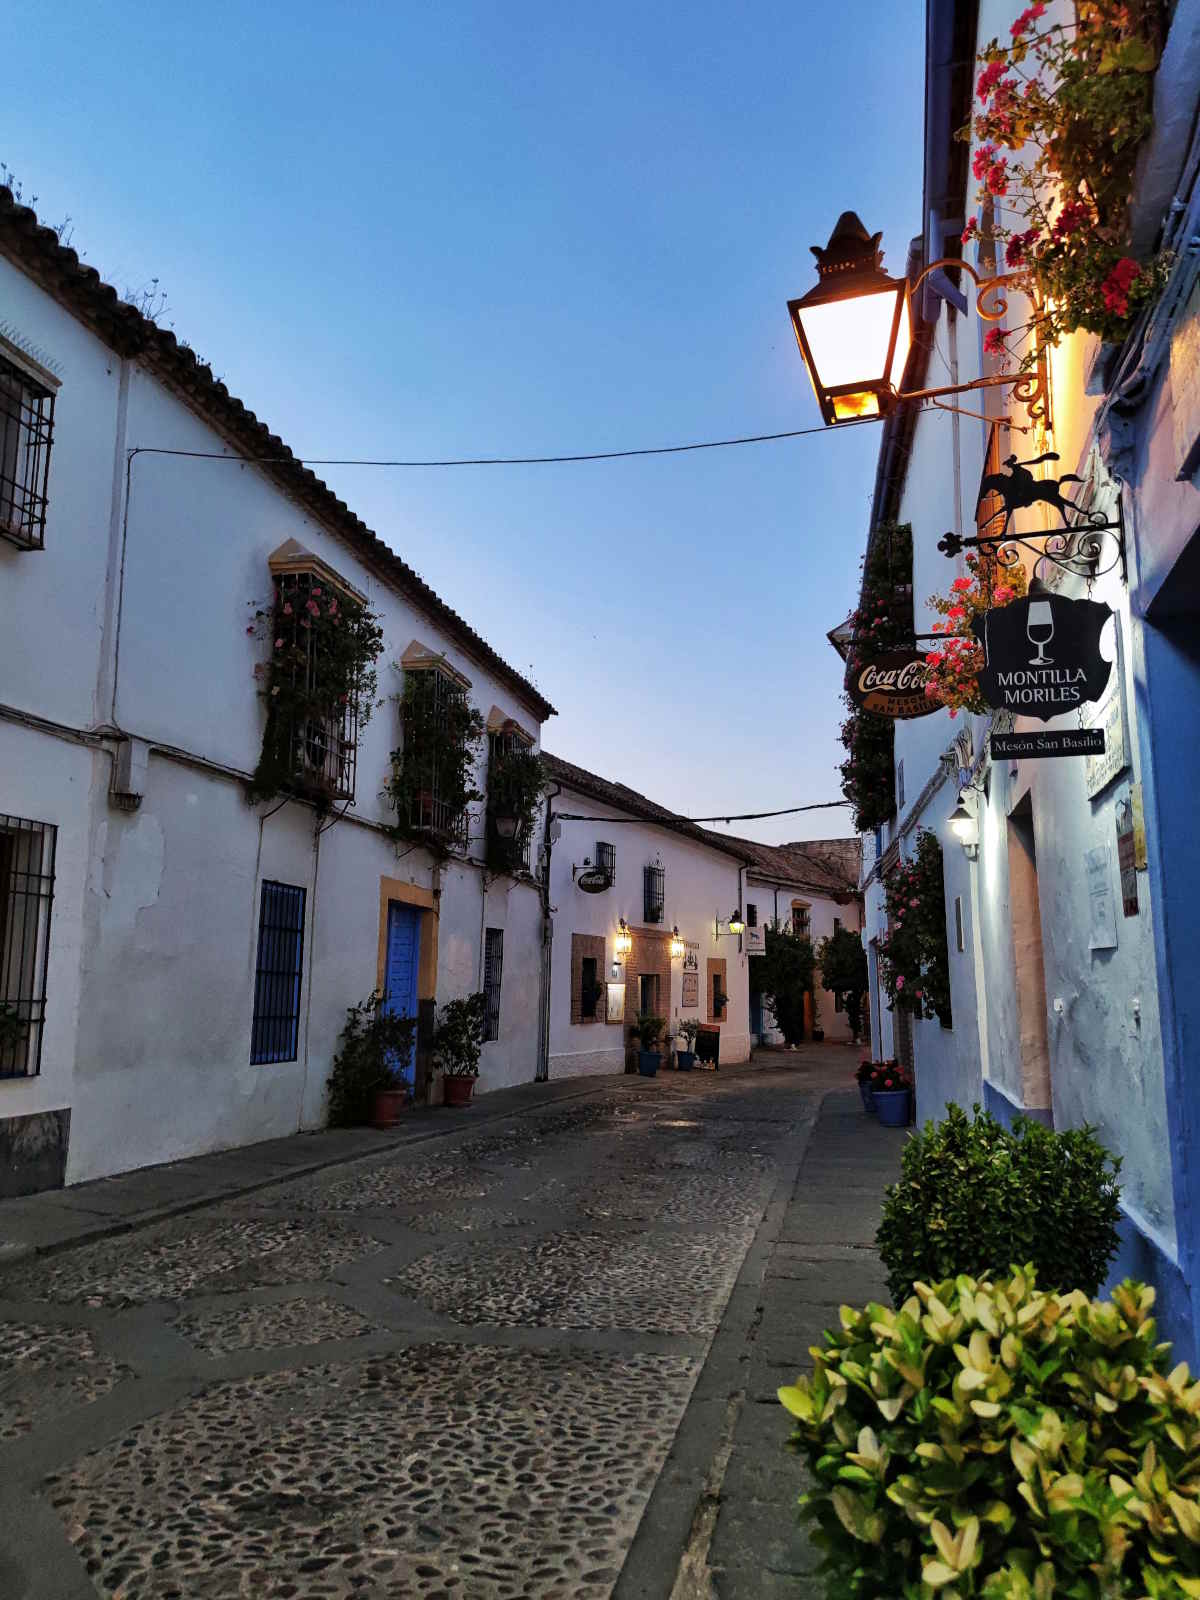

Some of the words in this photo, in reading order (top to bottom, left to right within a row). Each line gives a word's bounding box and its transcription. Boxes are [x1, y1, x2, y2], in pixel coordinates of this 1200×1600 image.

[858, 661, 928, 692] Coca-Col
[997, 668, 1087, 686] MONTILLA
[1005, 686, 1080, 704] MORILES
[1036, 738, 1058, 750] San
[1062, 735, 1102, 748] Basilio
